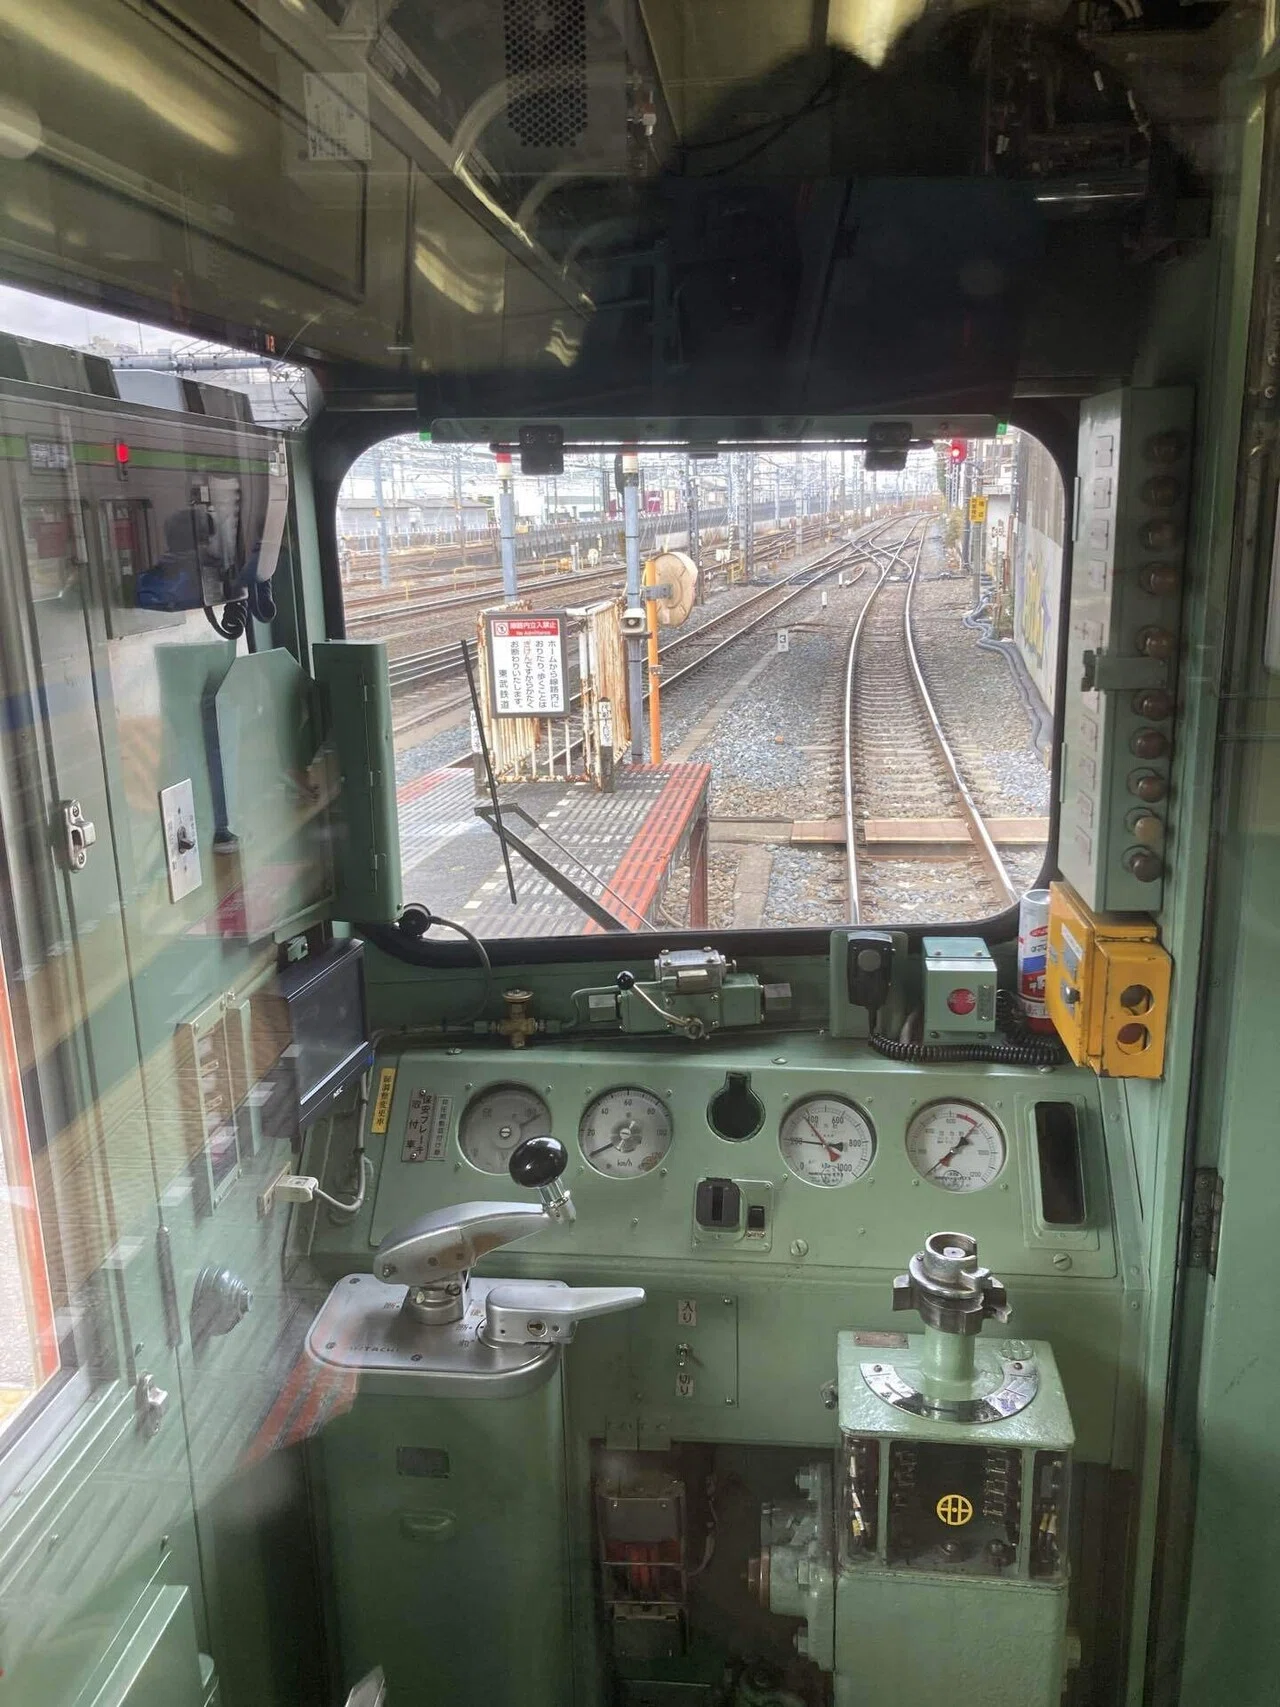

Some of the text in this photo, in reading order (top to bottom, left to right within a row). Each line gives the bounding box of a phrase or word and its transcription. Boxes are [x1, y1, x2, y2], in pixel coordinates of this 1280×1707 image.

[509, 620, 557, 630] 線路内立入禁止
[523, 639, 534, 708] きけんですからかたく
[548, 640, 560, 708] ホームから線路内に
[498, 669, 509, 709] 東武鉄道
[831, 1116, 844, 1124] 600
[587, 1128, 596, 1137] 20
[848, 1139, 862, 1147] 800
[617, 1159, 633, 1167] km/h
[682, 1300, 694, 1323] 入り
[679, 1374, 691, 1396] 切り
